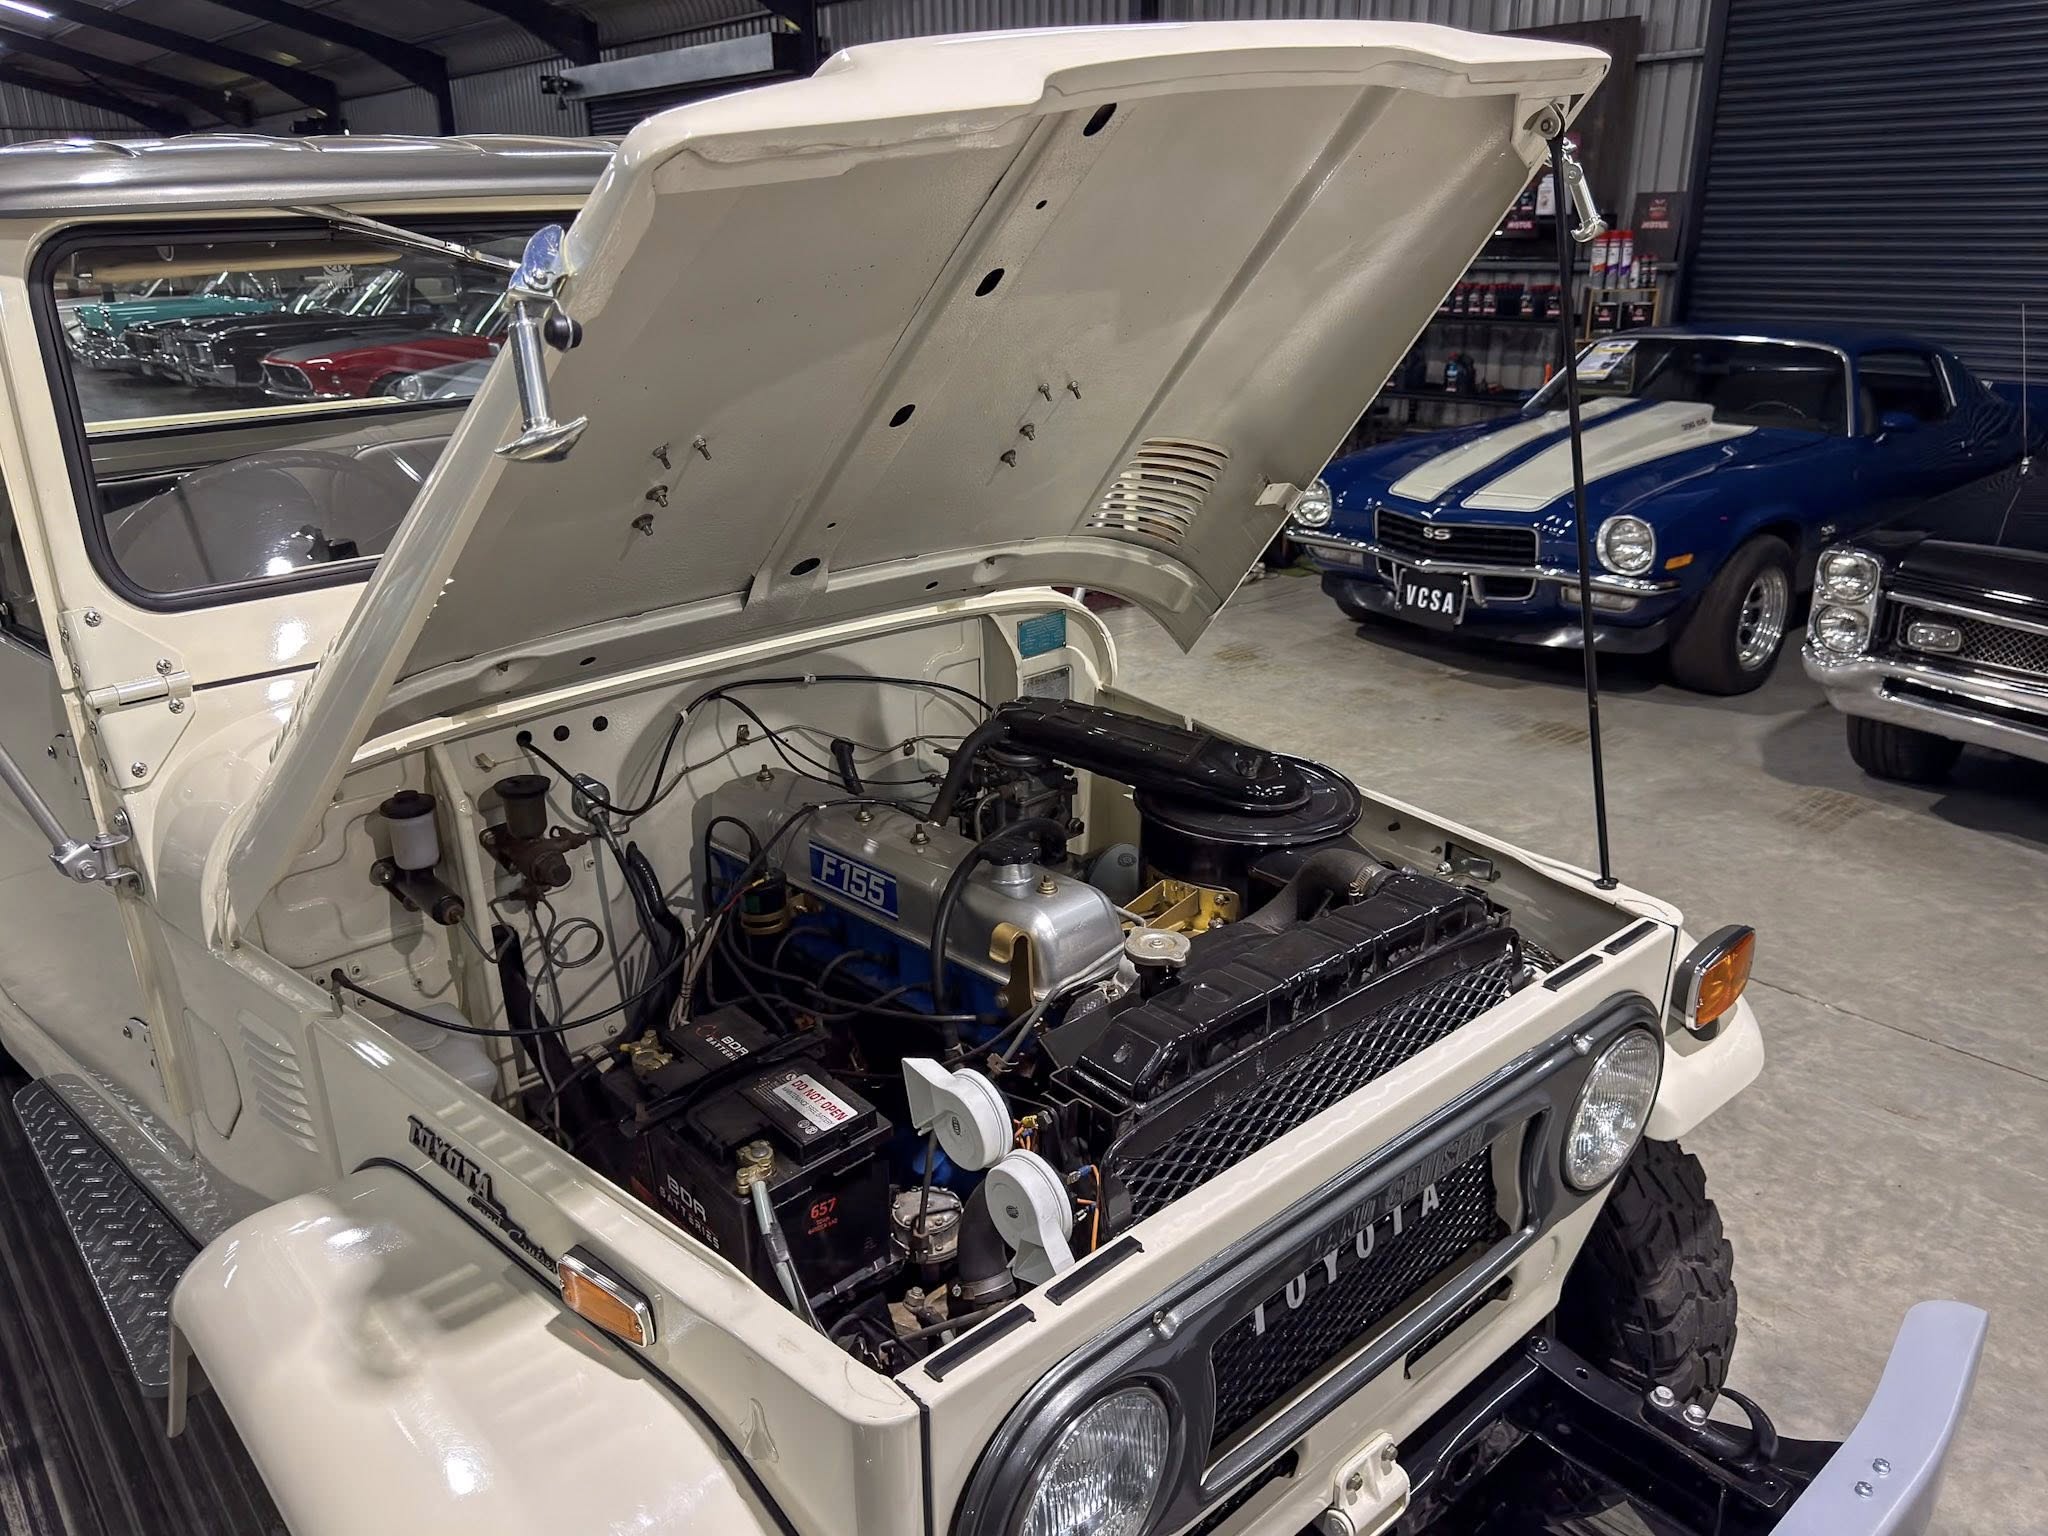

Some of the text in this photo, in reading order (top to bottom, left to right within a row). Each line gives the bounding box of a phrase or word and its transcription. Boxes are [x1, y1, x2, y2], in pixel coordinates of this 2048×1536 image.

[1423, 526, 1451, 540] SS
[1406, 583, 1453, 614] VCSA
[705, 1034, 740, 1062] BATTERI
[791, 1079, 807, 1092] DO
[803, 1088, 826, 1104] NOT
[820, 1101, 849, 1121] OPEN
[407, 1115, 492, 1201] TOYOTA
[659, 1185, 720, 1250] BATTERIES
[810, 1197, 837, 1219] 657
[1254, 1182, 1440, 1336] TOYOTA
